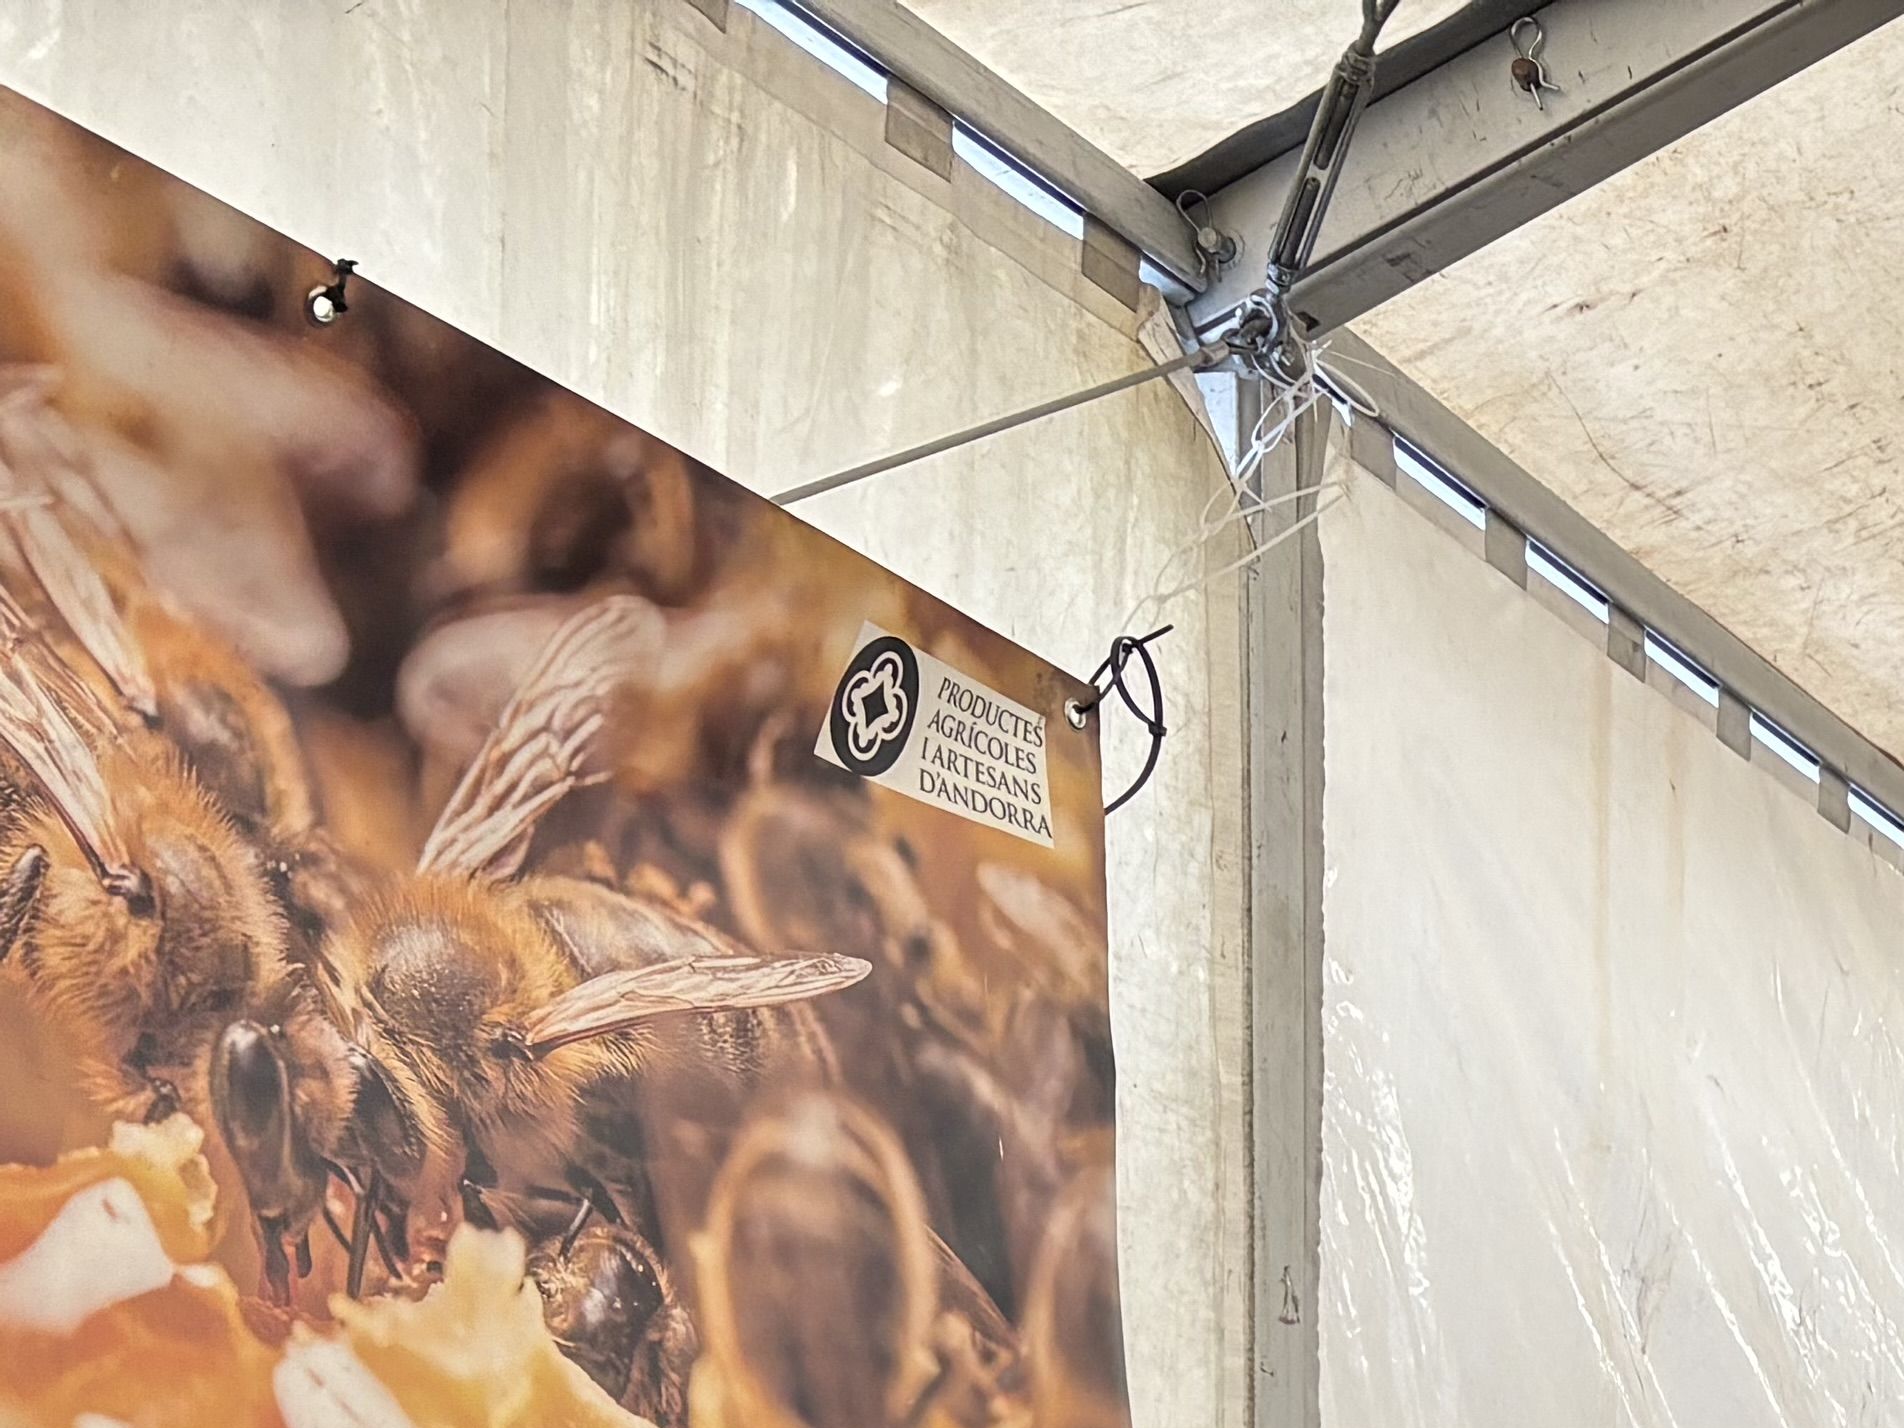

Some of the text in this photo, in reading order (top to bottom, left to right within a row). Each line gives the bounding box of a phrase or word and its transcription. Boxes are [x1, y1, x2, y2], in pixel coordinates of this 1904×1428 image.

[926, 707, 1037, 775] AGRÍCOLES
[937, 675, 1045, 748] PRODUCTES
[918, 767, 1053, 840] D'ANDORRA
[930, 745, 1043, 806] ARTESANS
